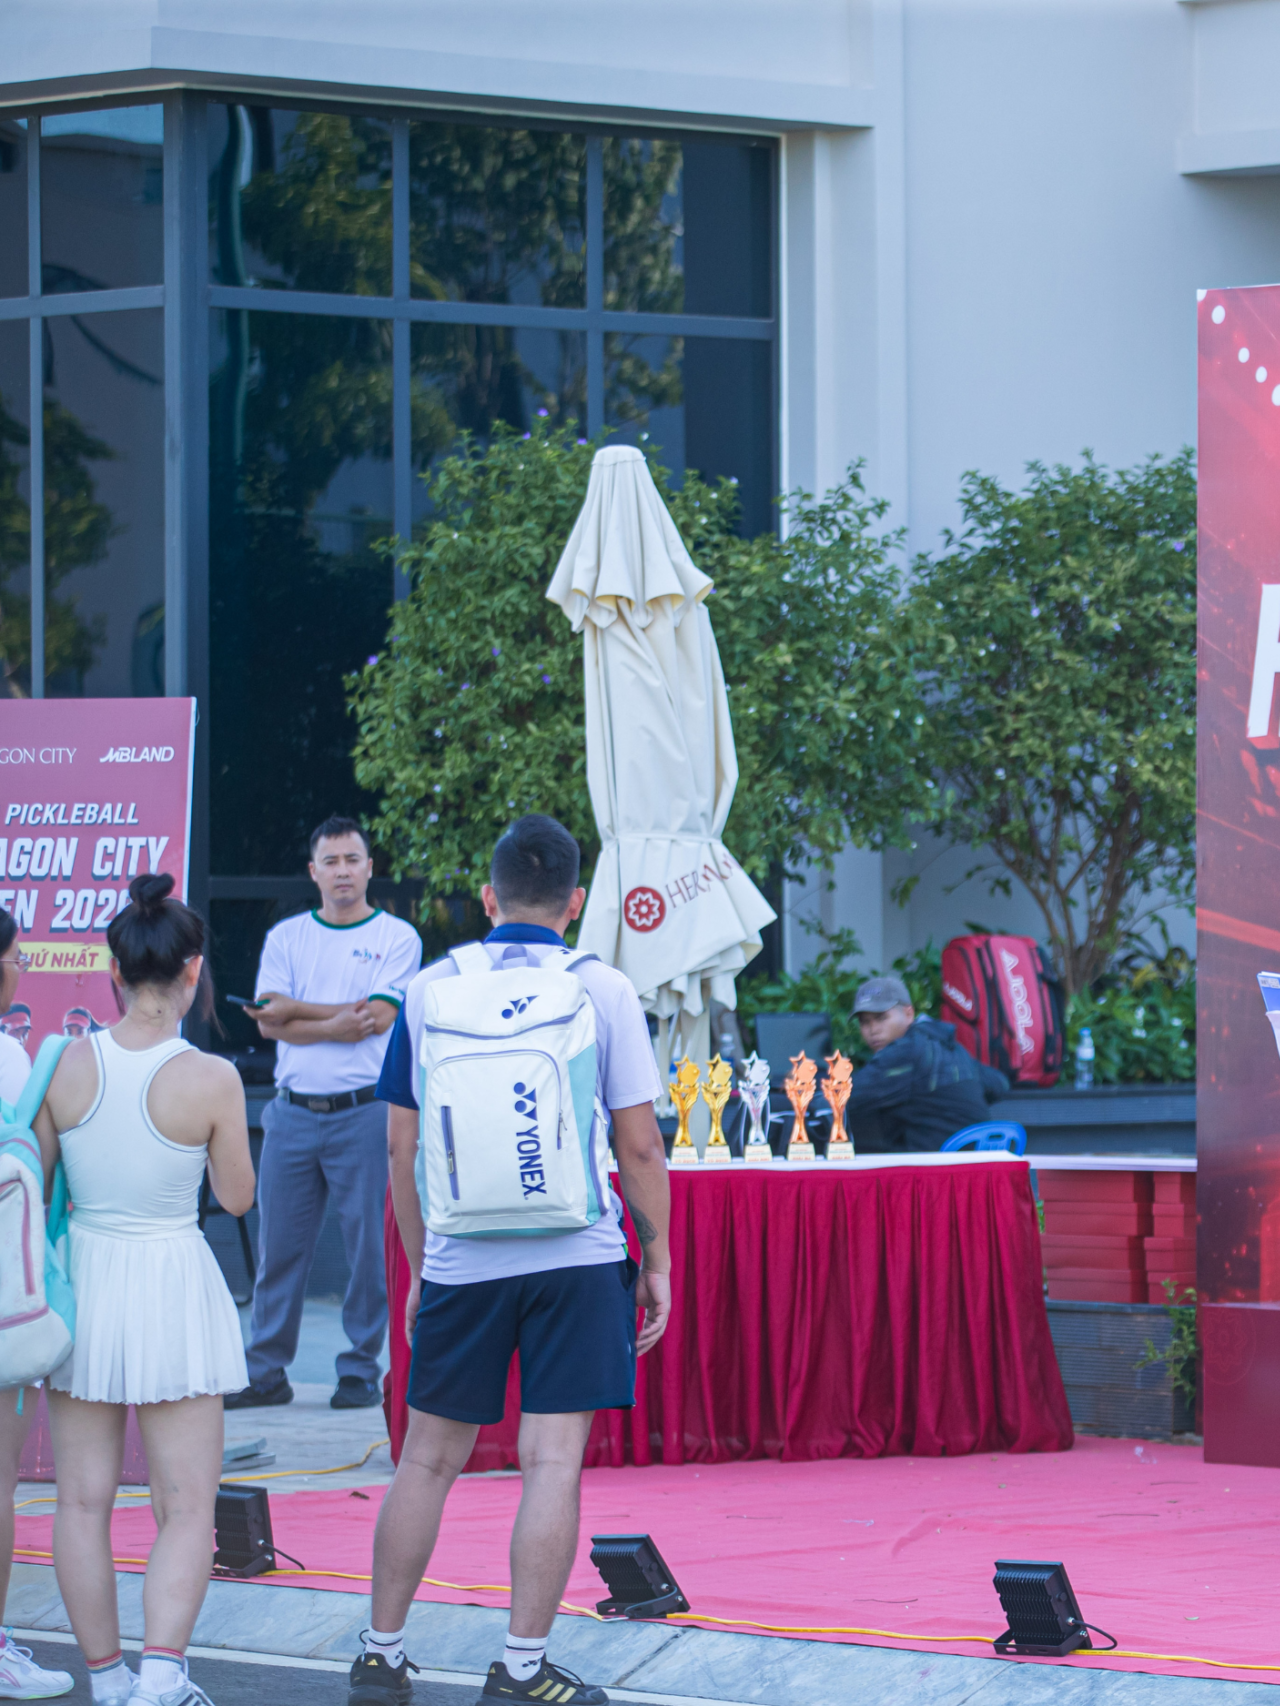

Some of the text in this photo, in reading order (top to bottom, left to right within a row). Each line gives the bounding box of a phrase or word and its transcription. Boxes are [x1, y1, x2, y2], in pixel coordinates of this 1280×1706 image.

[40, 747, 77, 764] CITY
[5, 803, 139, 825] PICKLEBALL
[92, 836, 170, 877] CITY
[51, 946, 99, 968] NHẤT
[516, 1125, 547, 1195] YONEX
